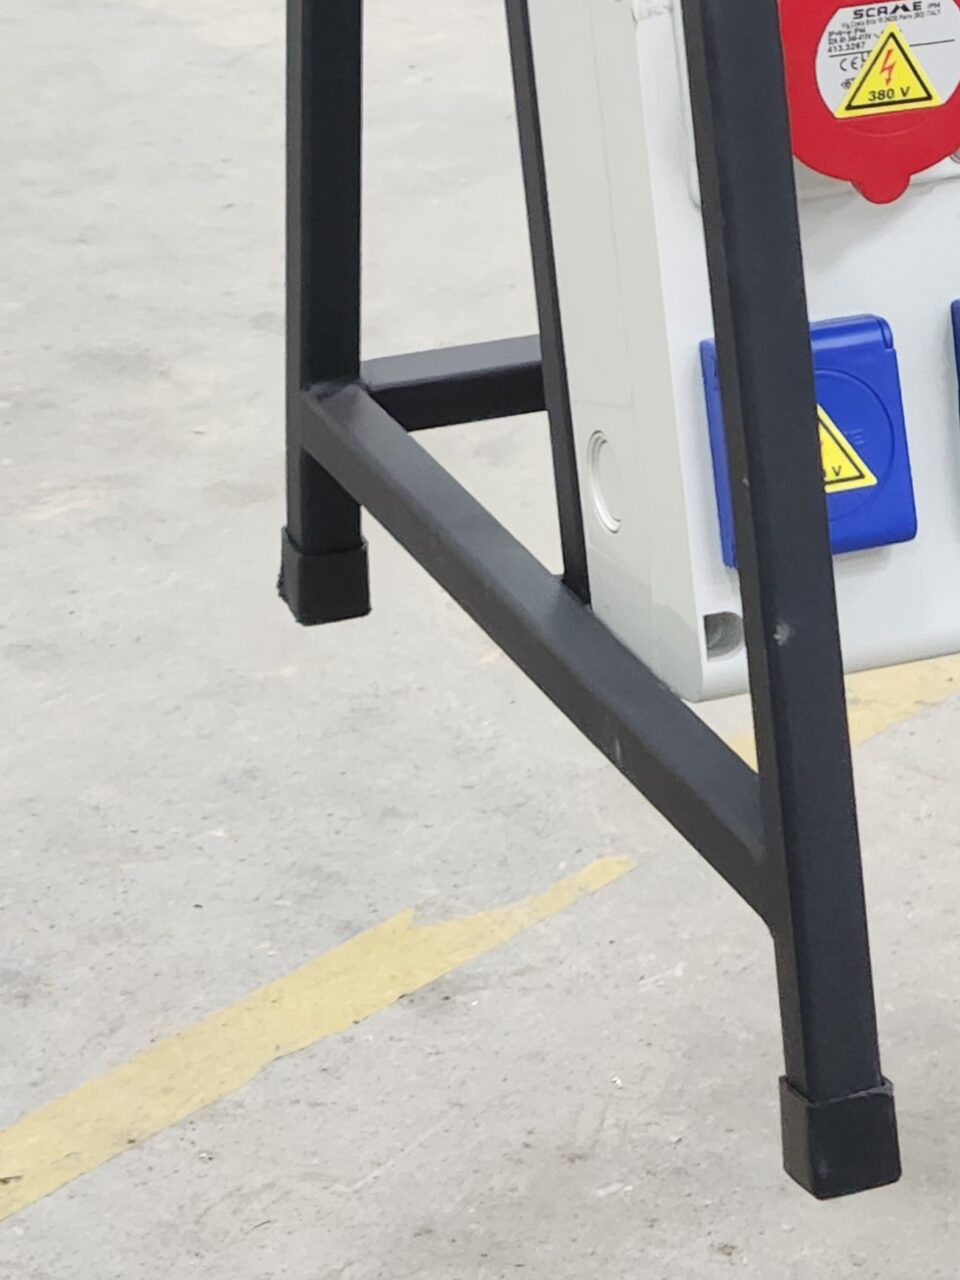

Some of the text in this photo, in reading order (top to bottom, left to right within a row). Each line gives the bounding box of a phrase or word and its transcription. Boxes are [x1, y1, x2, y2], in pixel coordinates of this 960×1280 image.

[853, 1, 922, 20] SCAME
[868, 86, 911, 101] 380 V
